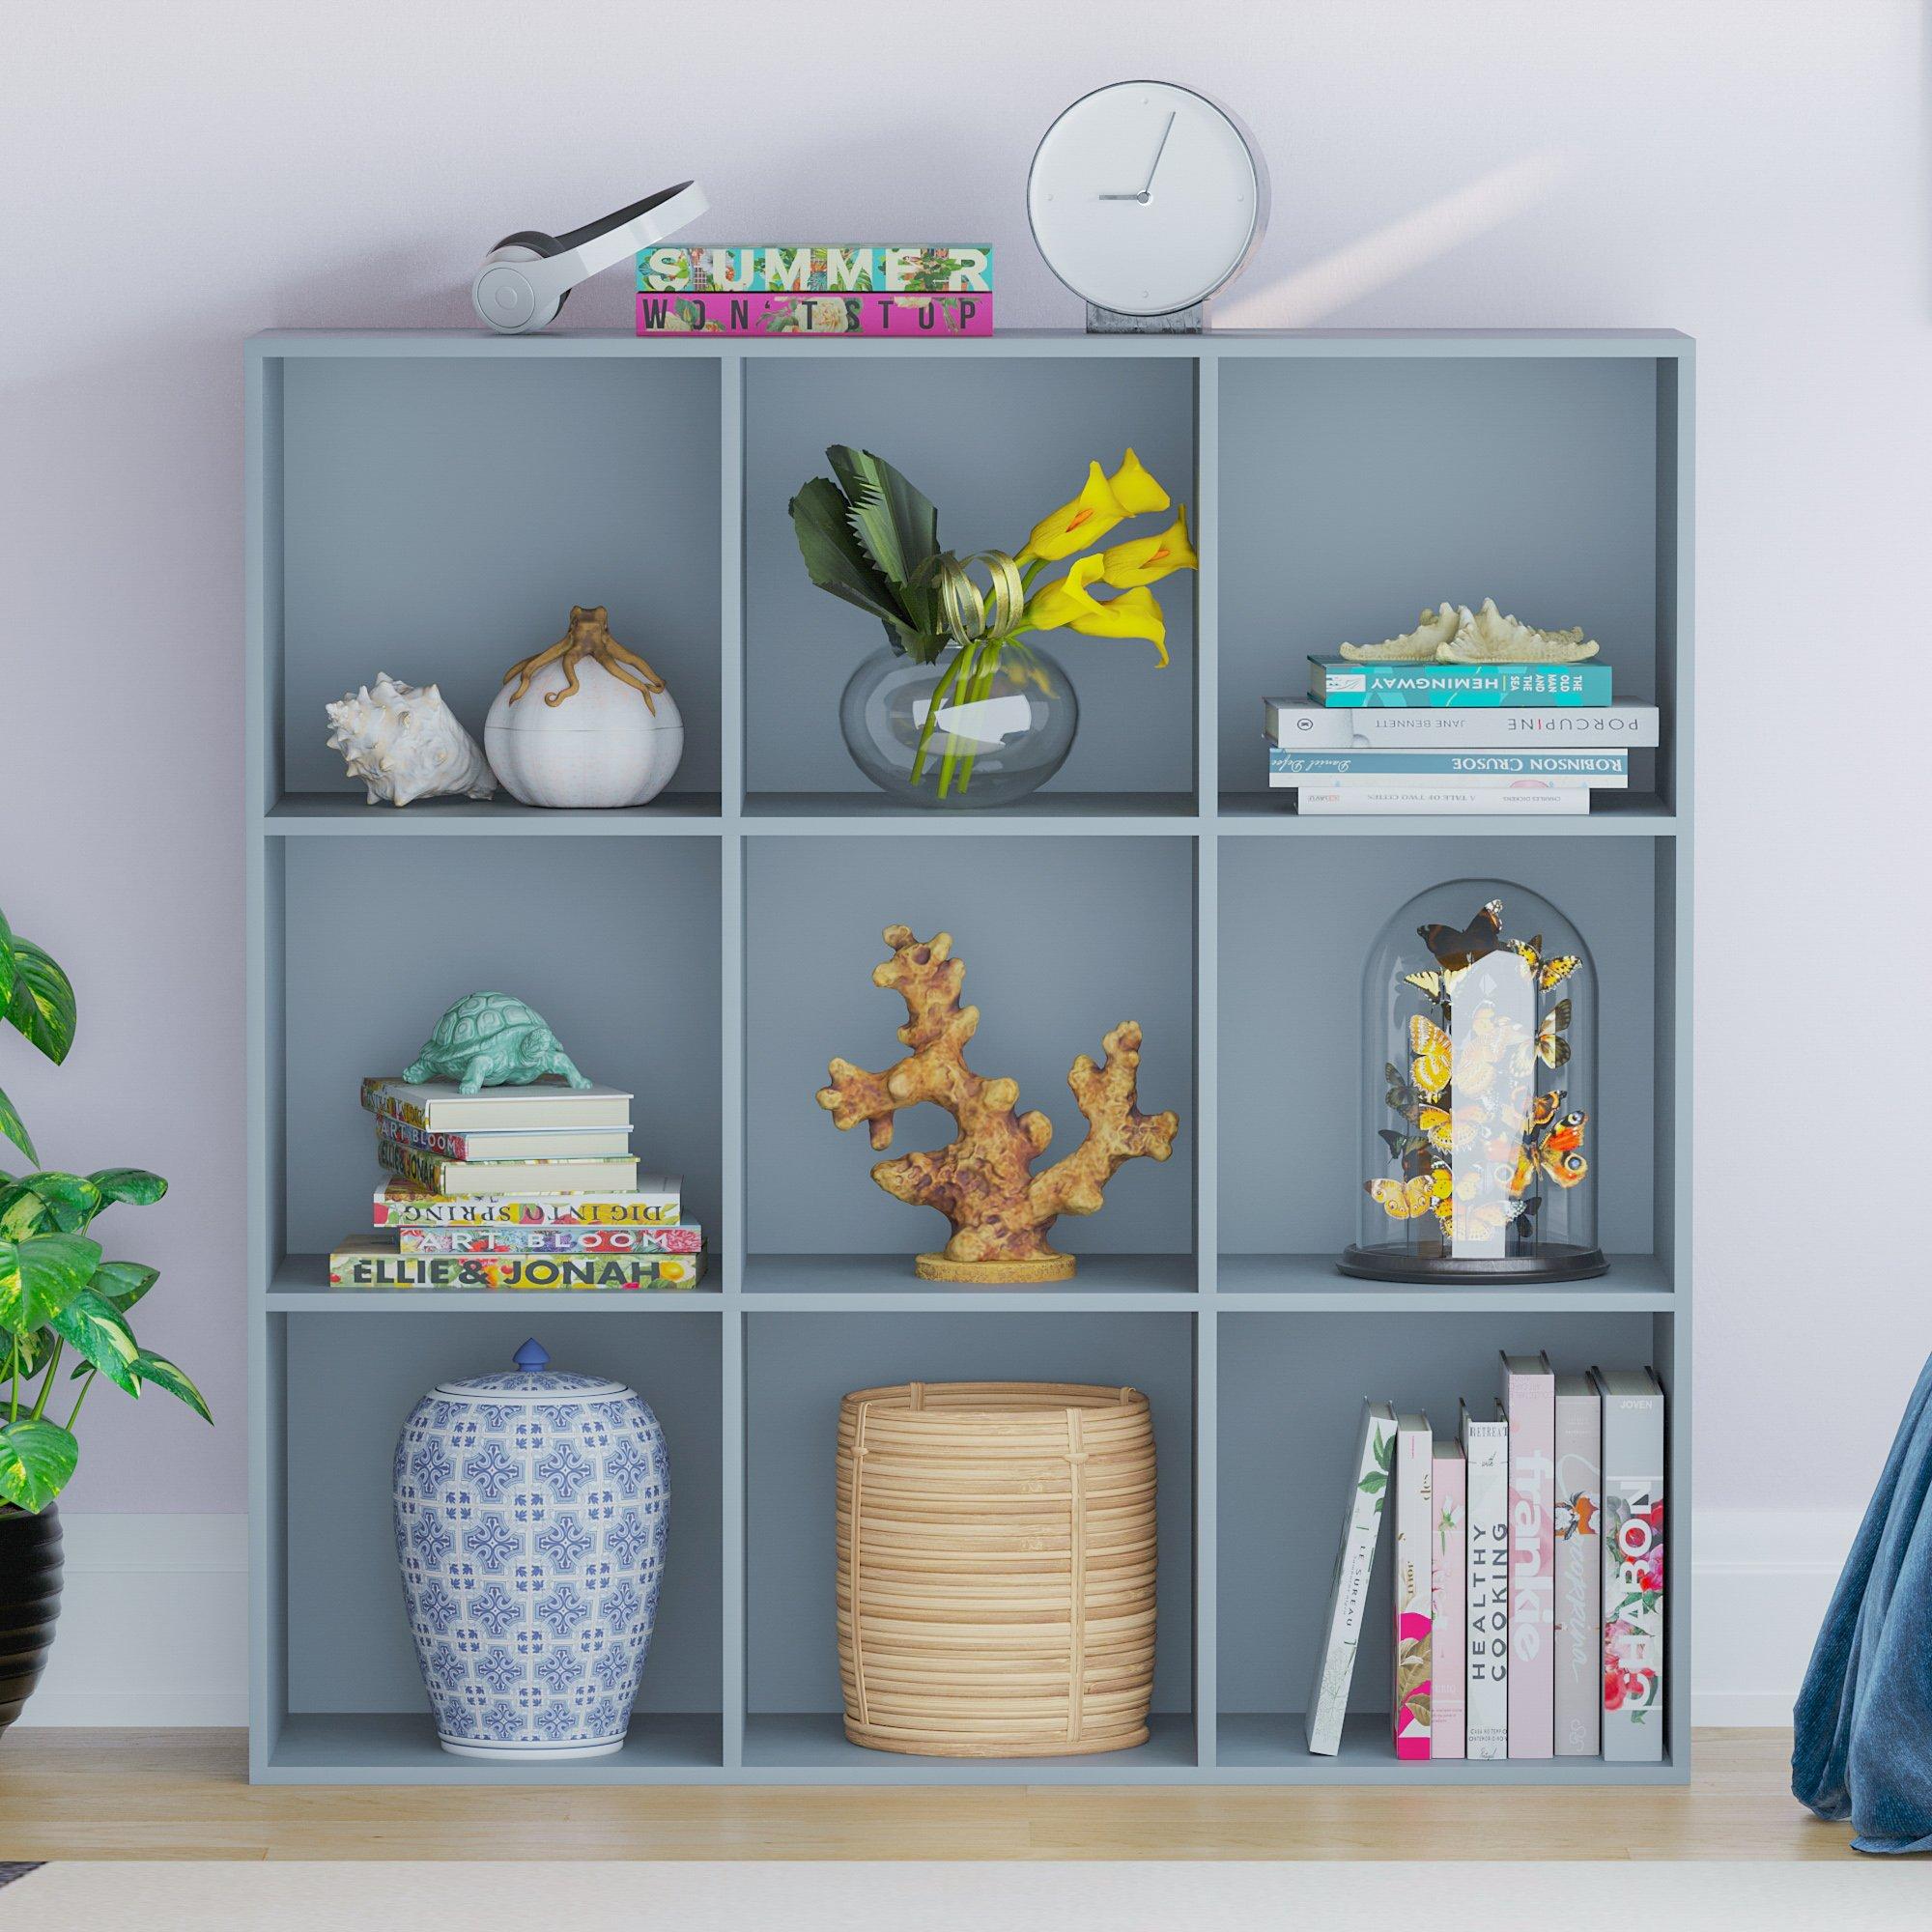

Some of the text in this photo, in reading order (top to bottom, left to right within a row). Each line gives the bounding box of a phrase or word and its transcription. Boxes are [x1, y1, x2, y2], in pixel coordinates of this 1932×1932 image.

[648, 247, 989, 292] SUMMER
[845, 298, 977, 330] STOP
[1370, 677, 1498, 690] HEMINGWAY
[1510, 675, 1520, 692] SEA
[1522, 674, 1532, 692] THE
[1535, 673, 1545, 693] AND
[1548, 673, 1557, 693] MAN
[1560, 674, 1570, 692] OLD
[1573, 674, 1582, 692] THE
[1375, 720, 1469, 728] JANE BENNETT
[1507, 718, 1639, 731] PORCUPINE
[1452, 757, 1623, 772] ROBINSON CRUSOE
[381, 1121, 457, 1158] ART BLOOM
[404, 1205, 663, 1222] DIG INTO SPRING
[419, 1232, 670, 1249] ART BLOOM
[354, 1259, 660, 1286] ELLIE & JONAH
[1619, 1400, 1653, 1409] JOVEN
[1469, 1426, 1508, 1437] RETREAT
[1514, 1449, 1554, 1662] frankie
[1346, 1568, 1362, 1627] SUREAU
[1472, 1524, 1486, 1680] HEALTHY
[1492, 1523, 1507, 1682] COOKING
[1618, 1480, 1653, 1711] CHABON
